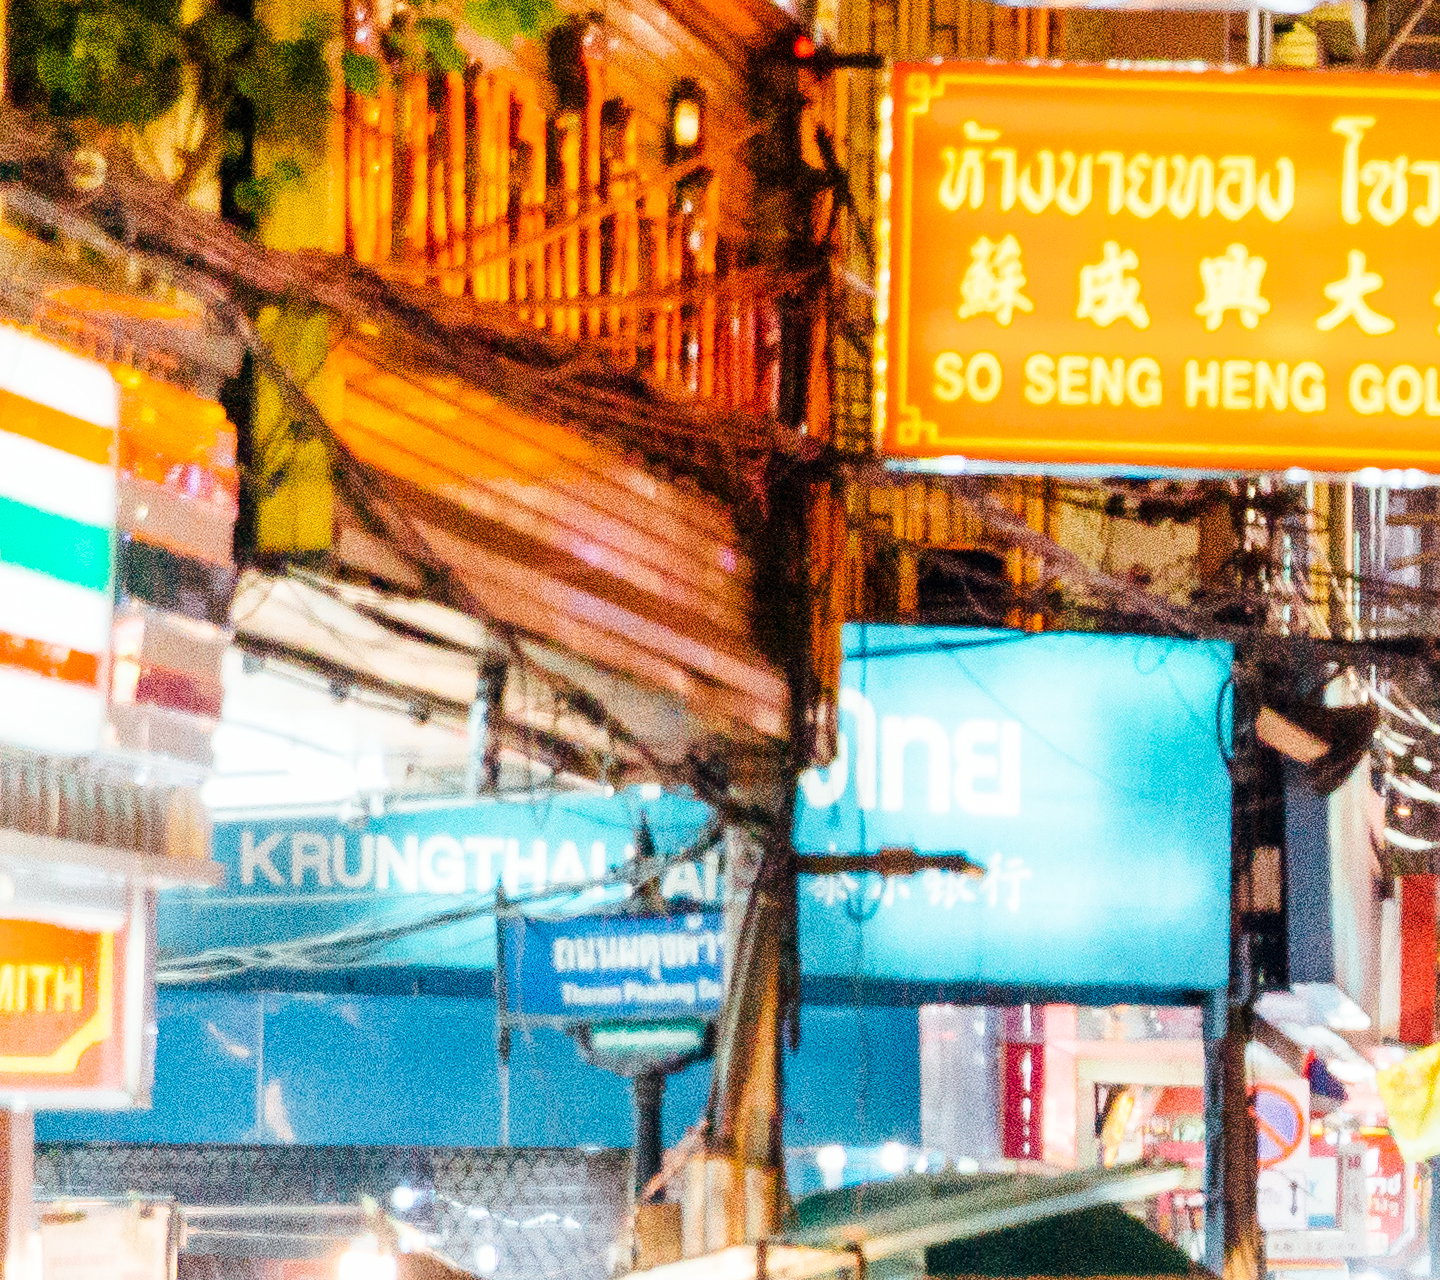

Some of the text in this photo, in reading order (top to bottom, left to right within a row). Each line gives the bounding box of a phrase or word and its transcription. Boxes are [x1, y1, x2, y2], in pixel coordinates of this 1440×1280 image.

[938, 122, 1295, 218] ห้างขายทอง
[933, 352, 1002, 405] SO
[1024, 355, 1163, 408] SENG
[1185, 360, 1326, 414] HENG
